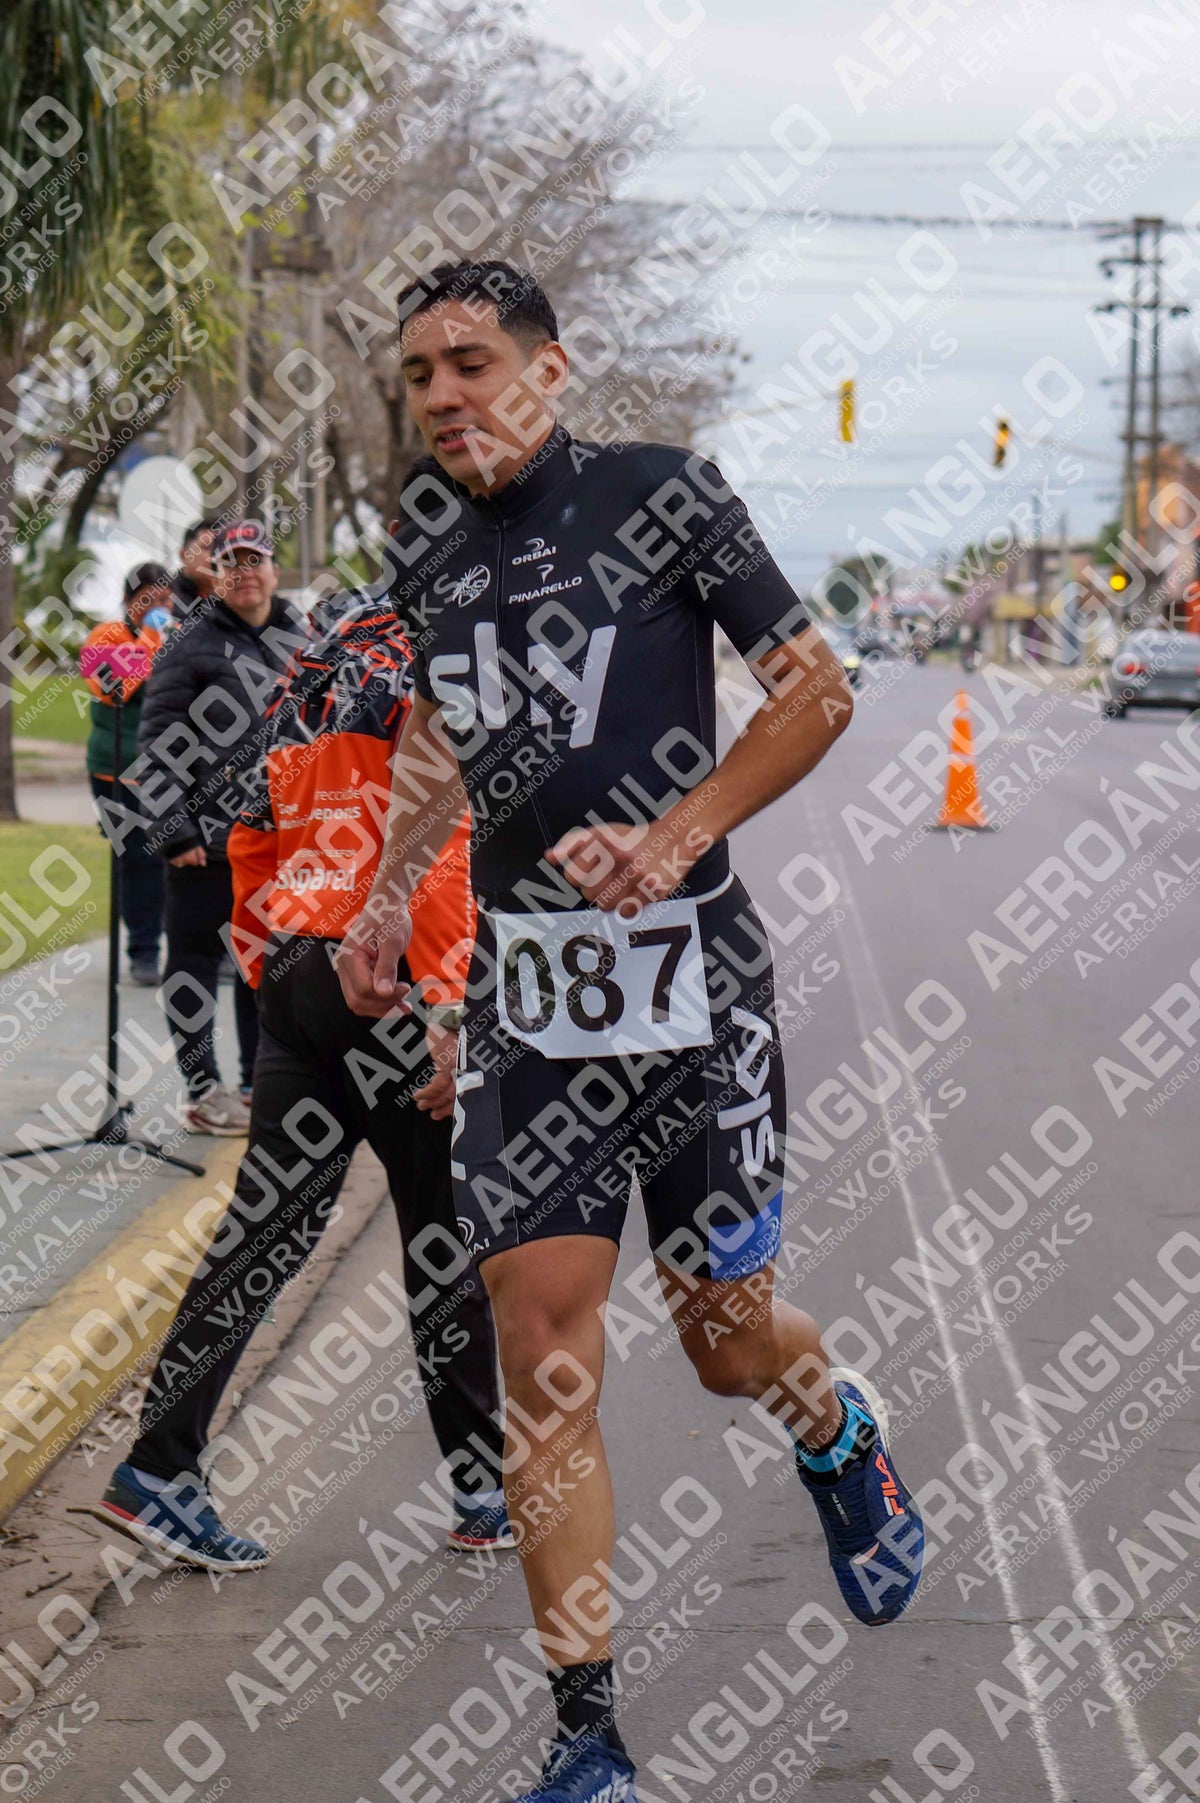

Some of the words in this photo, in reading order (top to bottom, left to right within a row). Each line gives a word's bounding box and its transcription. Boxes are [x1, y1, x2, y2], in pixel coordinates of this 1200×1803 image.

[511, 545, 557, 566] ORBAI
[508, 576, 583, 605] PINARELLO
[504, 924, 693, 1034] 087
[875, 1453, 906, 1517] FILA
